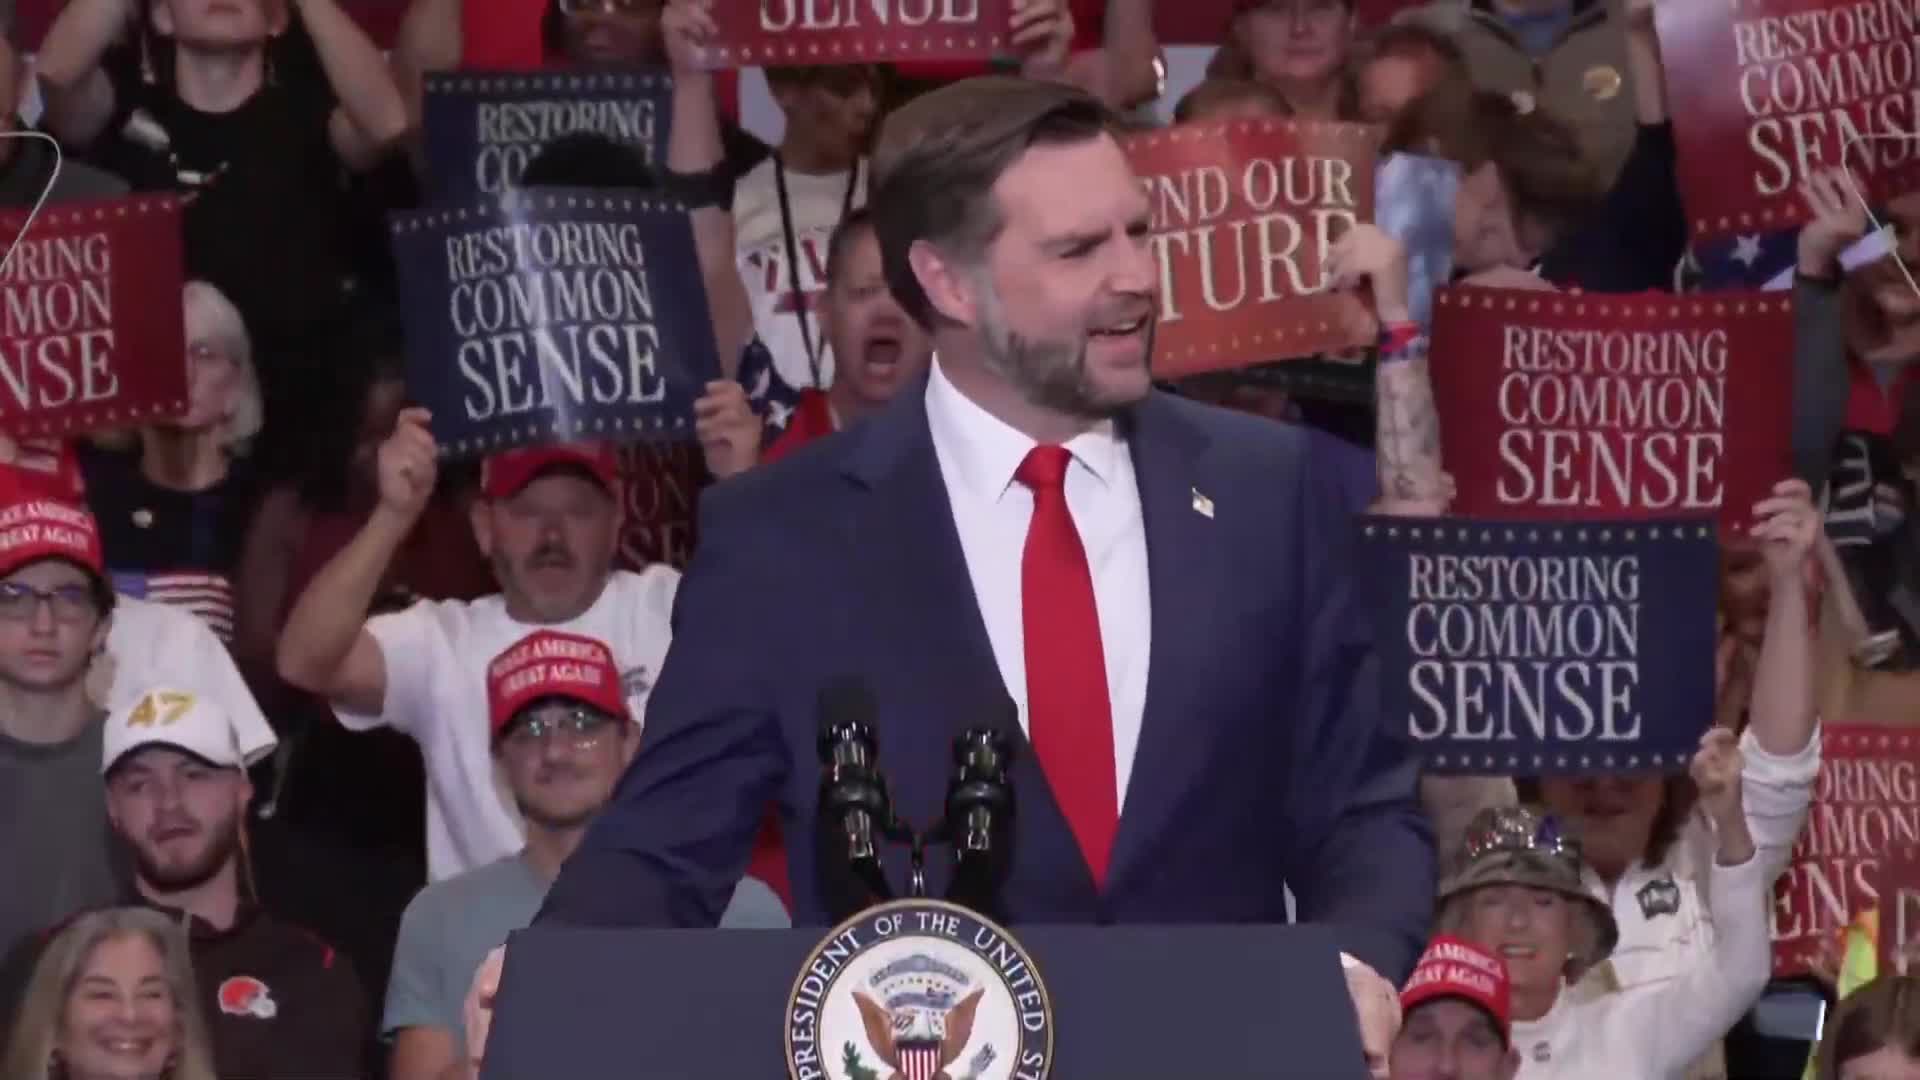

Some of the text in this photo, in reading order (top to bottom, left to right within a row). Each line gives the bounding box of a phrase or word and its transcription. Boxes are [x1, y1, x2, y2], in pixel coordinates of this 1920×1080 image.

[1734, 0, 1917, 66] RESTORIN
[478, 98, 655, 144] RESTORING
[1243, 156, 1355, 211] OUR
[447, 222, 644, 283] RESTORING
[451, 268, 653, 337] COMMON
[458, 323, 665, 421] SENSE
[1503, 326, 1728, 376] RESTORING
[1498, 372, 1726, 430] COMMON
[1496, 428, 1724, 508] SENSE
[1408, 553, 1640, 602] RESTORING
[1407, 602, 1640, 659] COMMON
[127, 692, 196, 728] 47
[1407, 660, 1642, 742] SENSE
[792, 927, 863, 1080] PRESIDENT
[874, 913, 904, 936] OF
[916, 911, 961, 937] THE
[974, 927, 1045, 1033] UNITED
